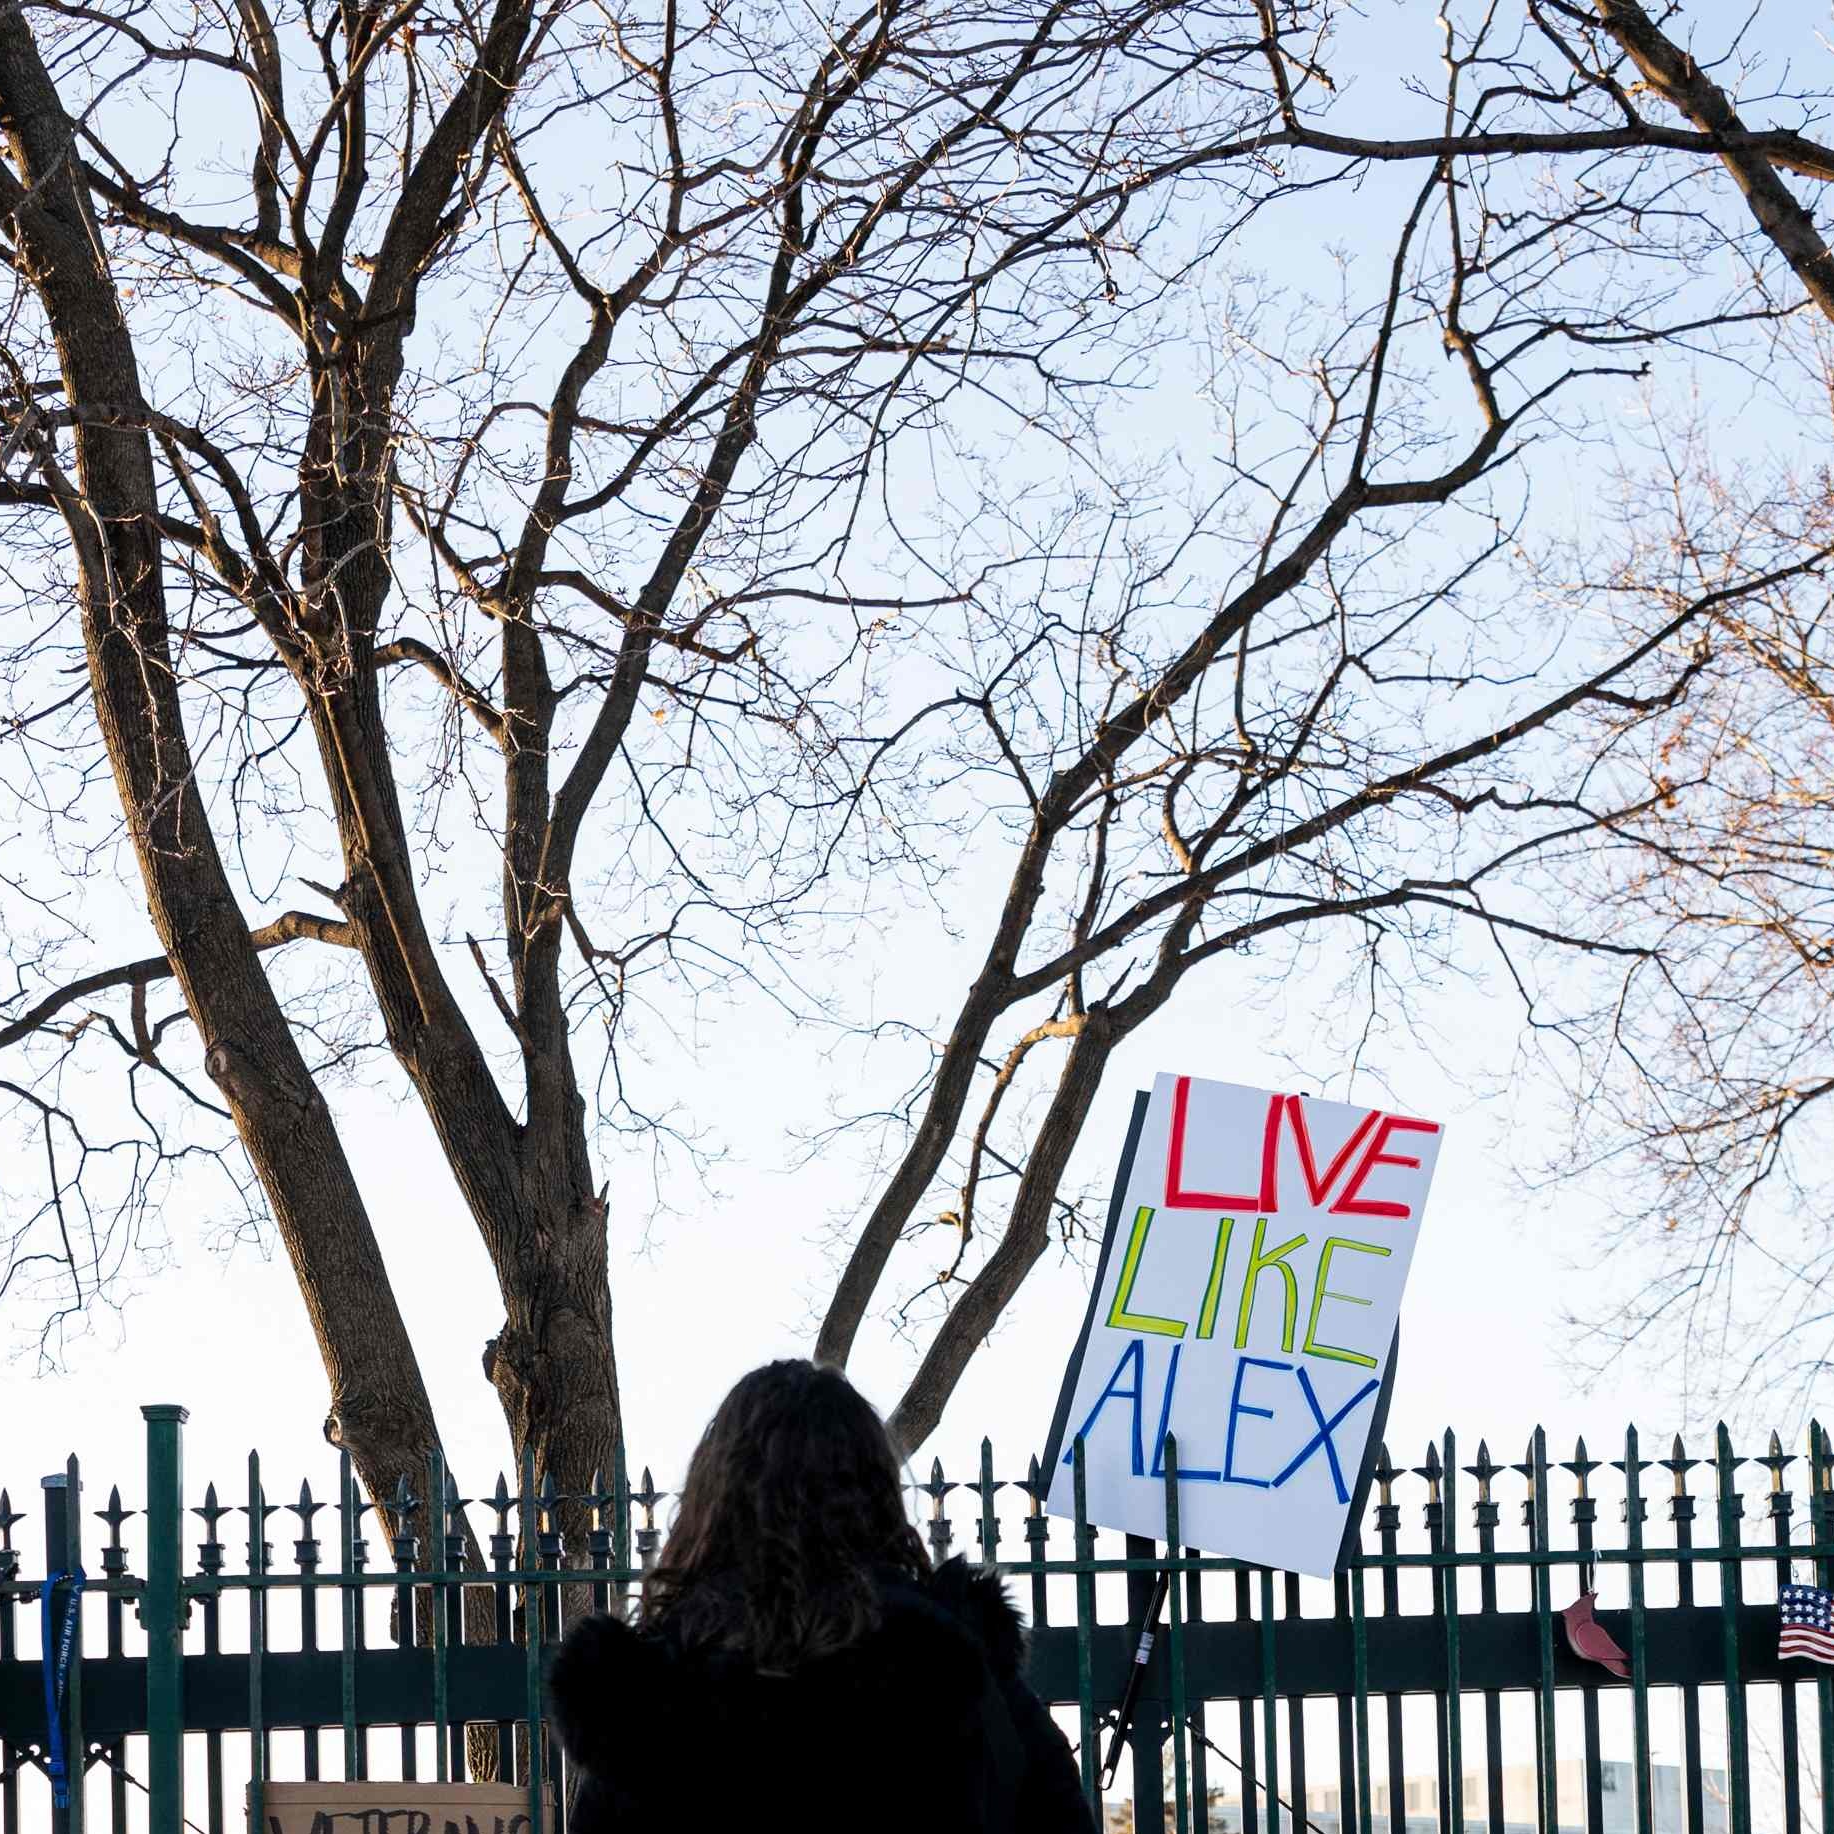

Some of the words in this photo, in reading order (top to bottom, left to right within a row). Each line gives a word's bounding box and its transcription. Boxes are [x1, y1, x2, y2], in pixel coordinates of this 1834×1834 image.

[1164, 1075, 1440, 1219] LIVE
[1105, 1206, 1392, 1369] LIKE
[1062, 1340, 1380, 1505] ALEX
[63, 1618, 73, 1637] AIR
